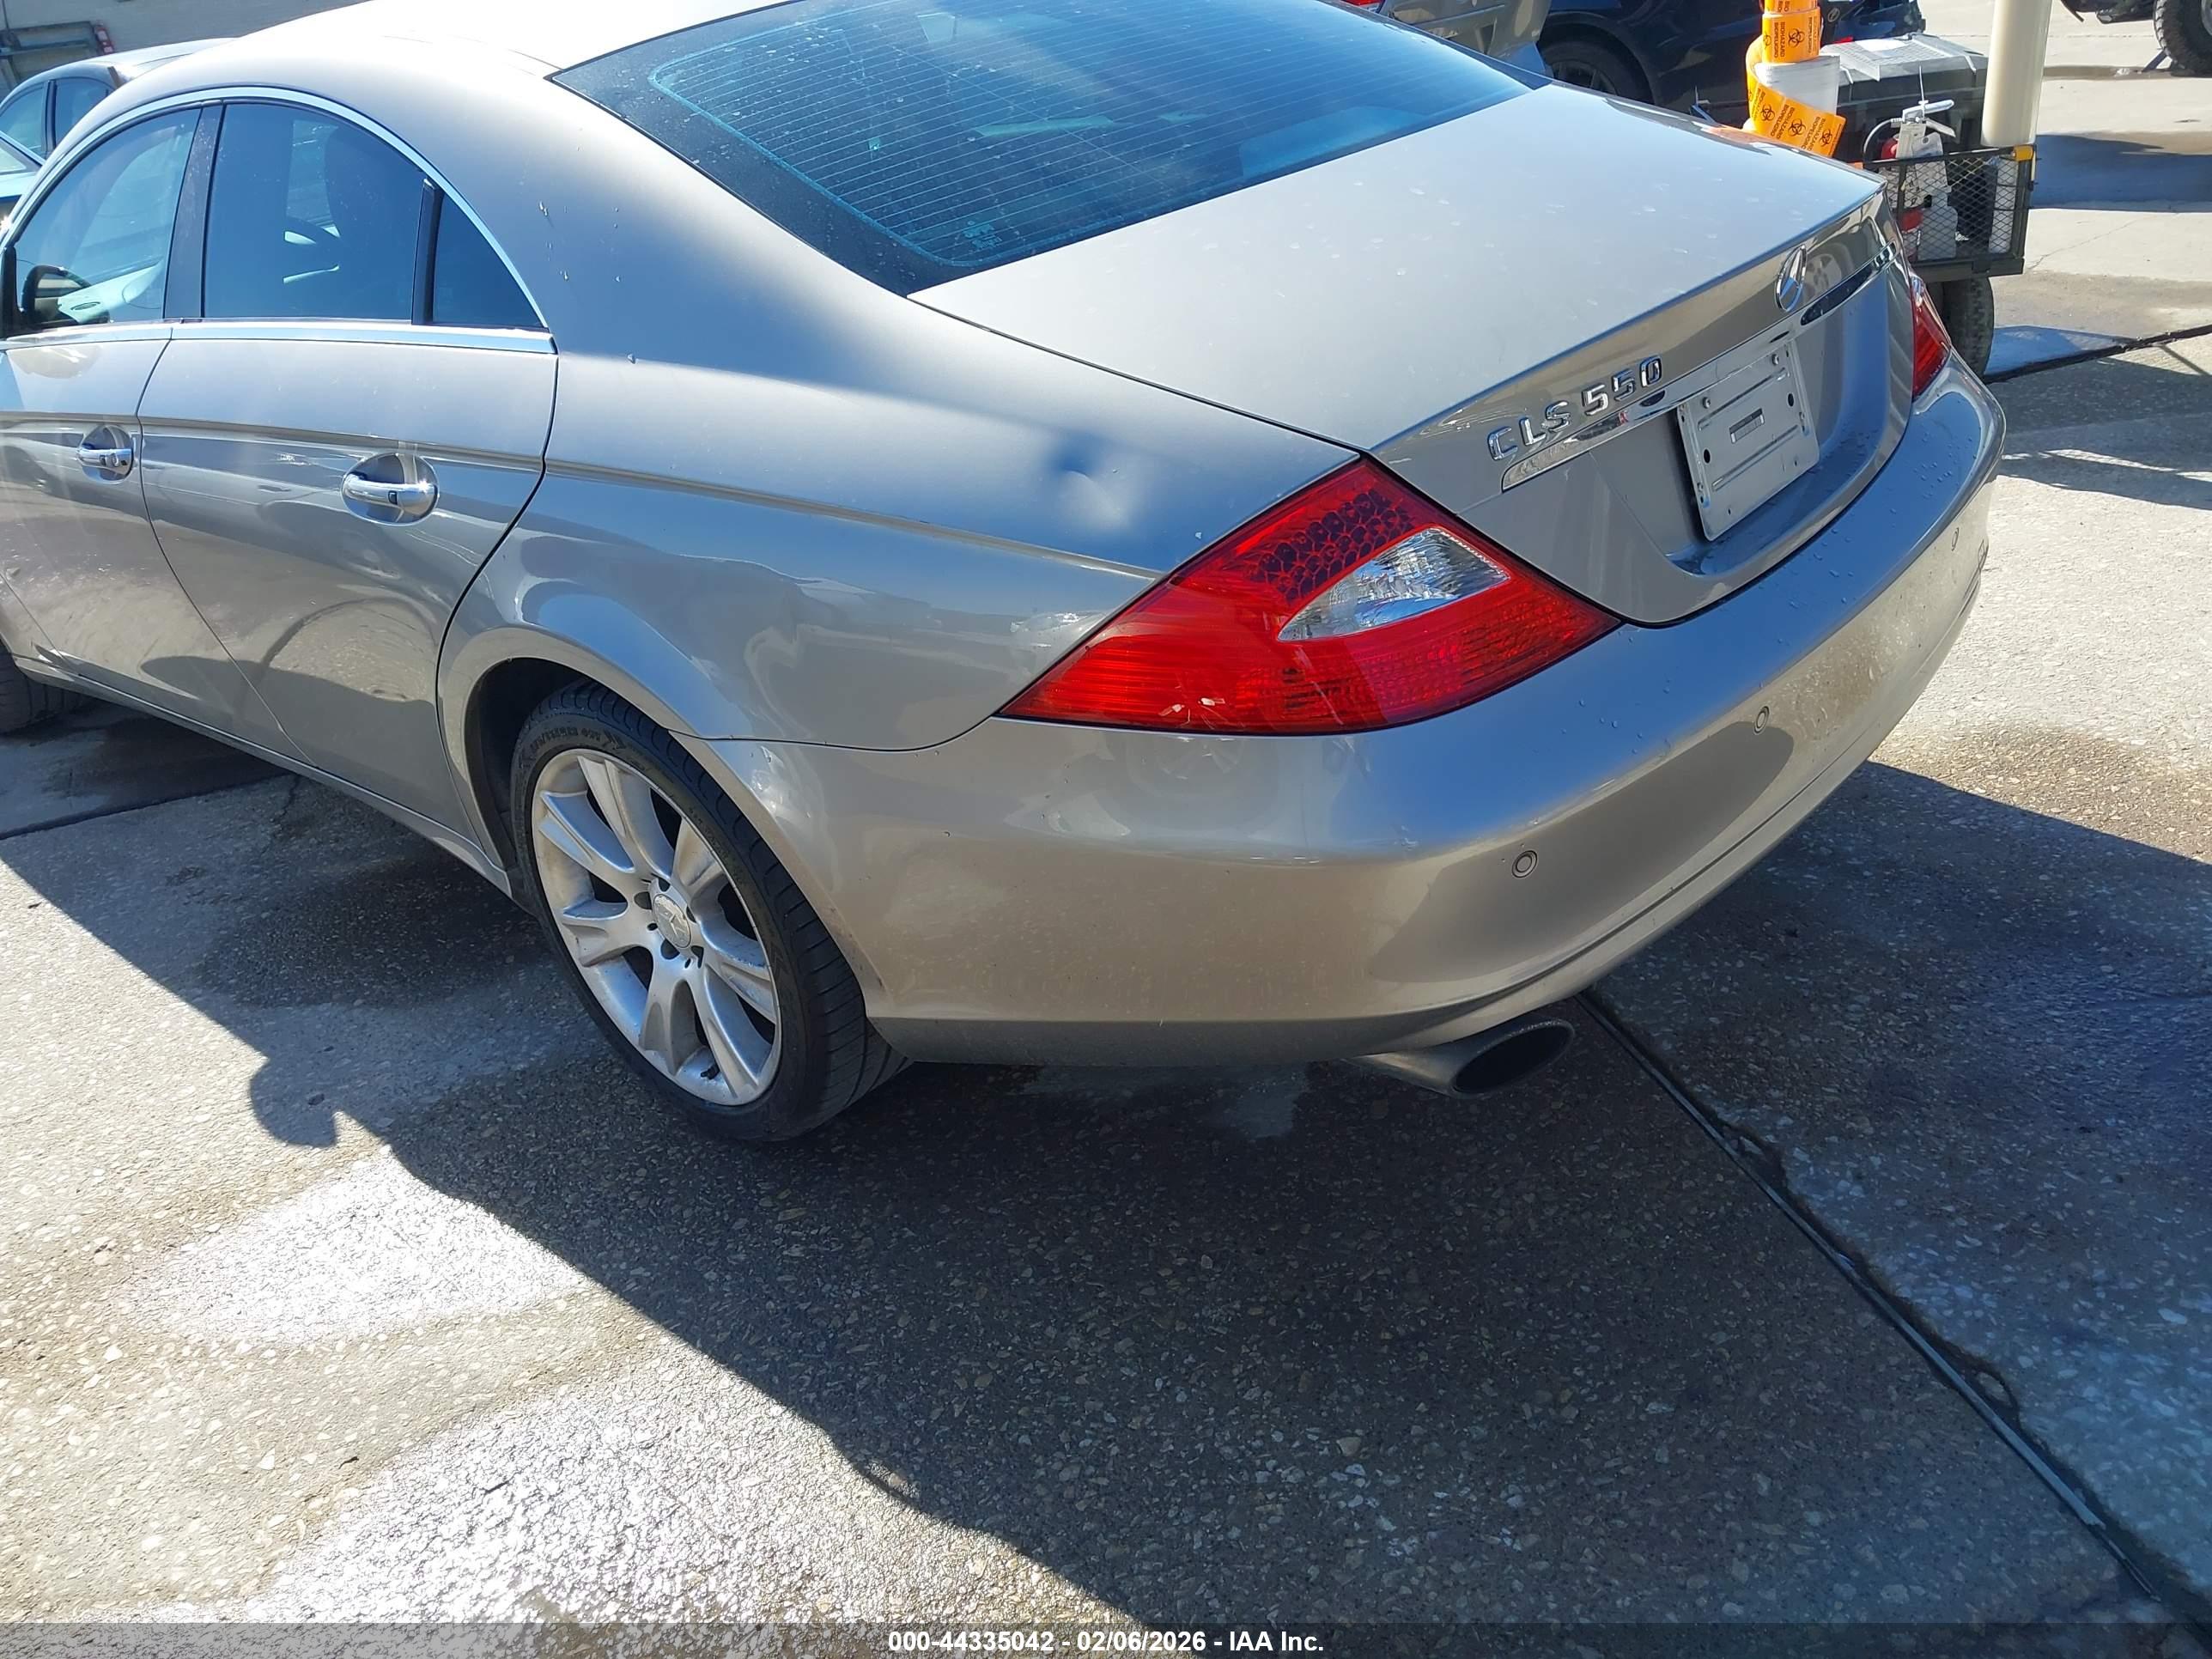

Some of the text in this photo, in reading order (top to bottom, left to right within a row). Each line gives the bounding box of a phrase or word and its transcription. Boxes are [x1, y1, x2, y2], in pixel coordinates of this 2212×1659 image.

[1771, 104, 1790, 137] BIOPELIGRO
[1777, 106, 1795, 139] BIOHAZARD
[1487, 355, 1662, 461] CLS 550
